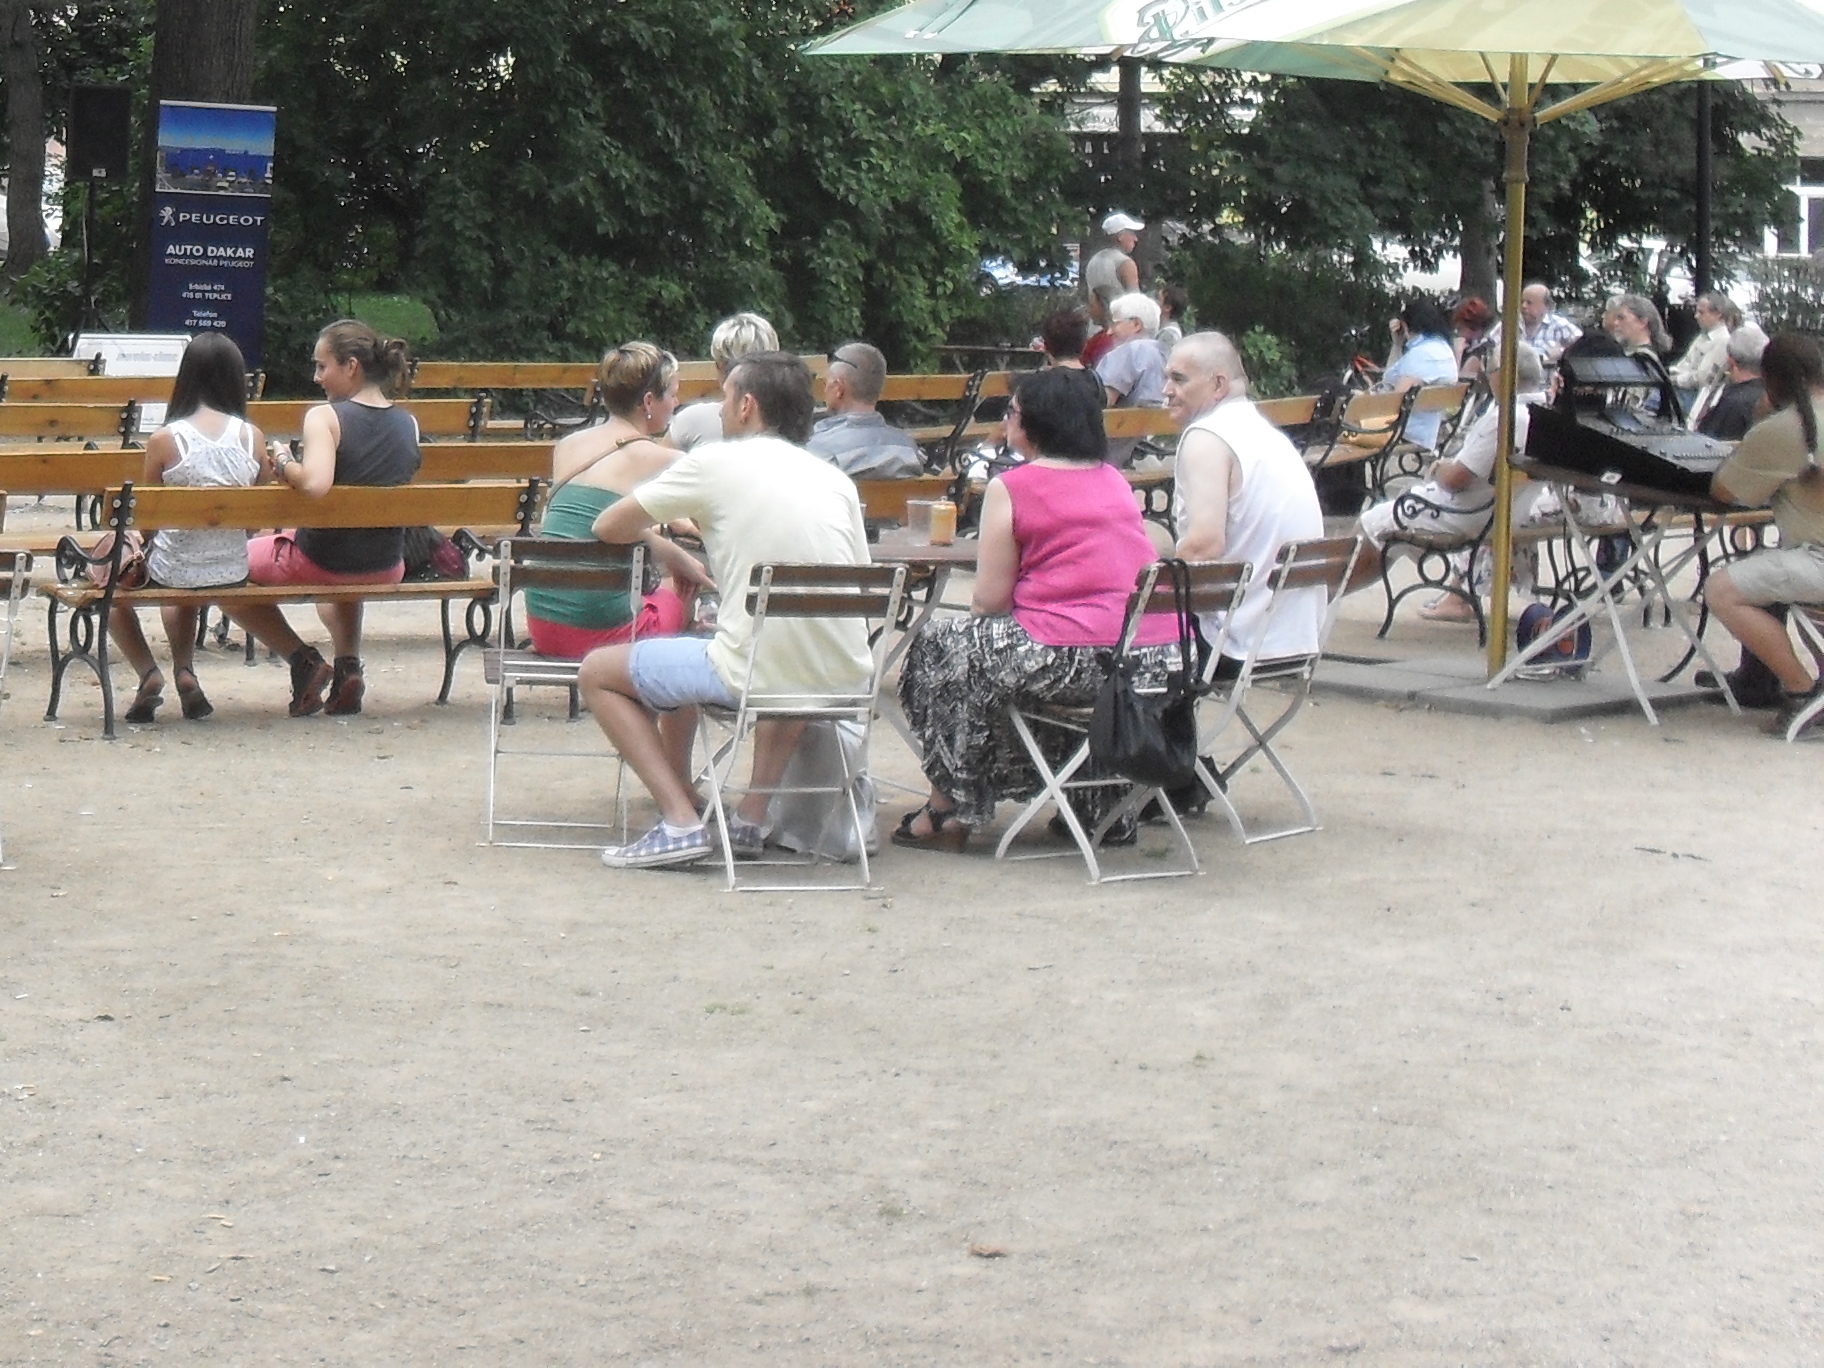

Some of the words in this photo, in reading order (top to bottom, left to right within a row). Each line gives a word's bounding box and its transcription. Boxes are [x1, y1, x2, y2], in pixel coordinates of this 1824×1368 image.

[179, 212, 266, 225] PEUGEOT
[165, 244, 204, 256] AUTO
[207, 246, 255, 258] DAKAR
[219, 260, 255, 268] PEUGEOT
